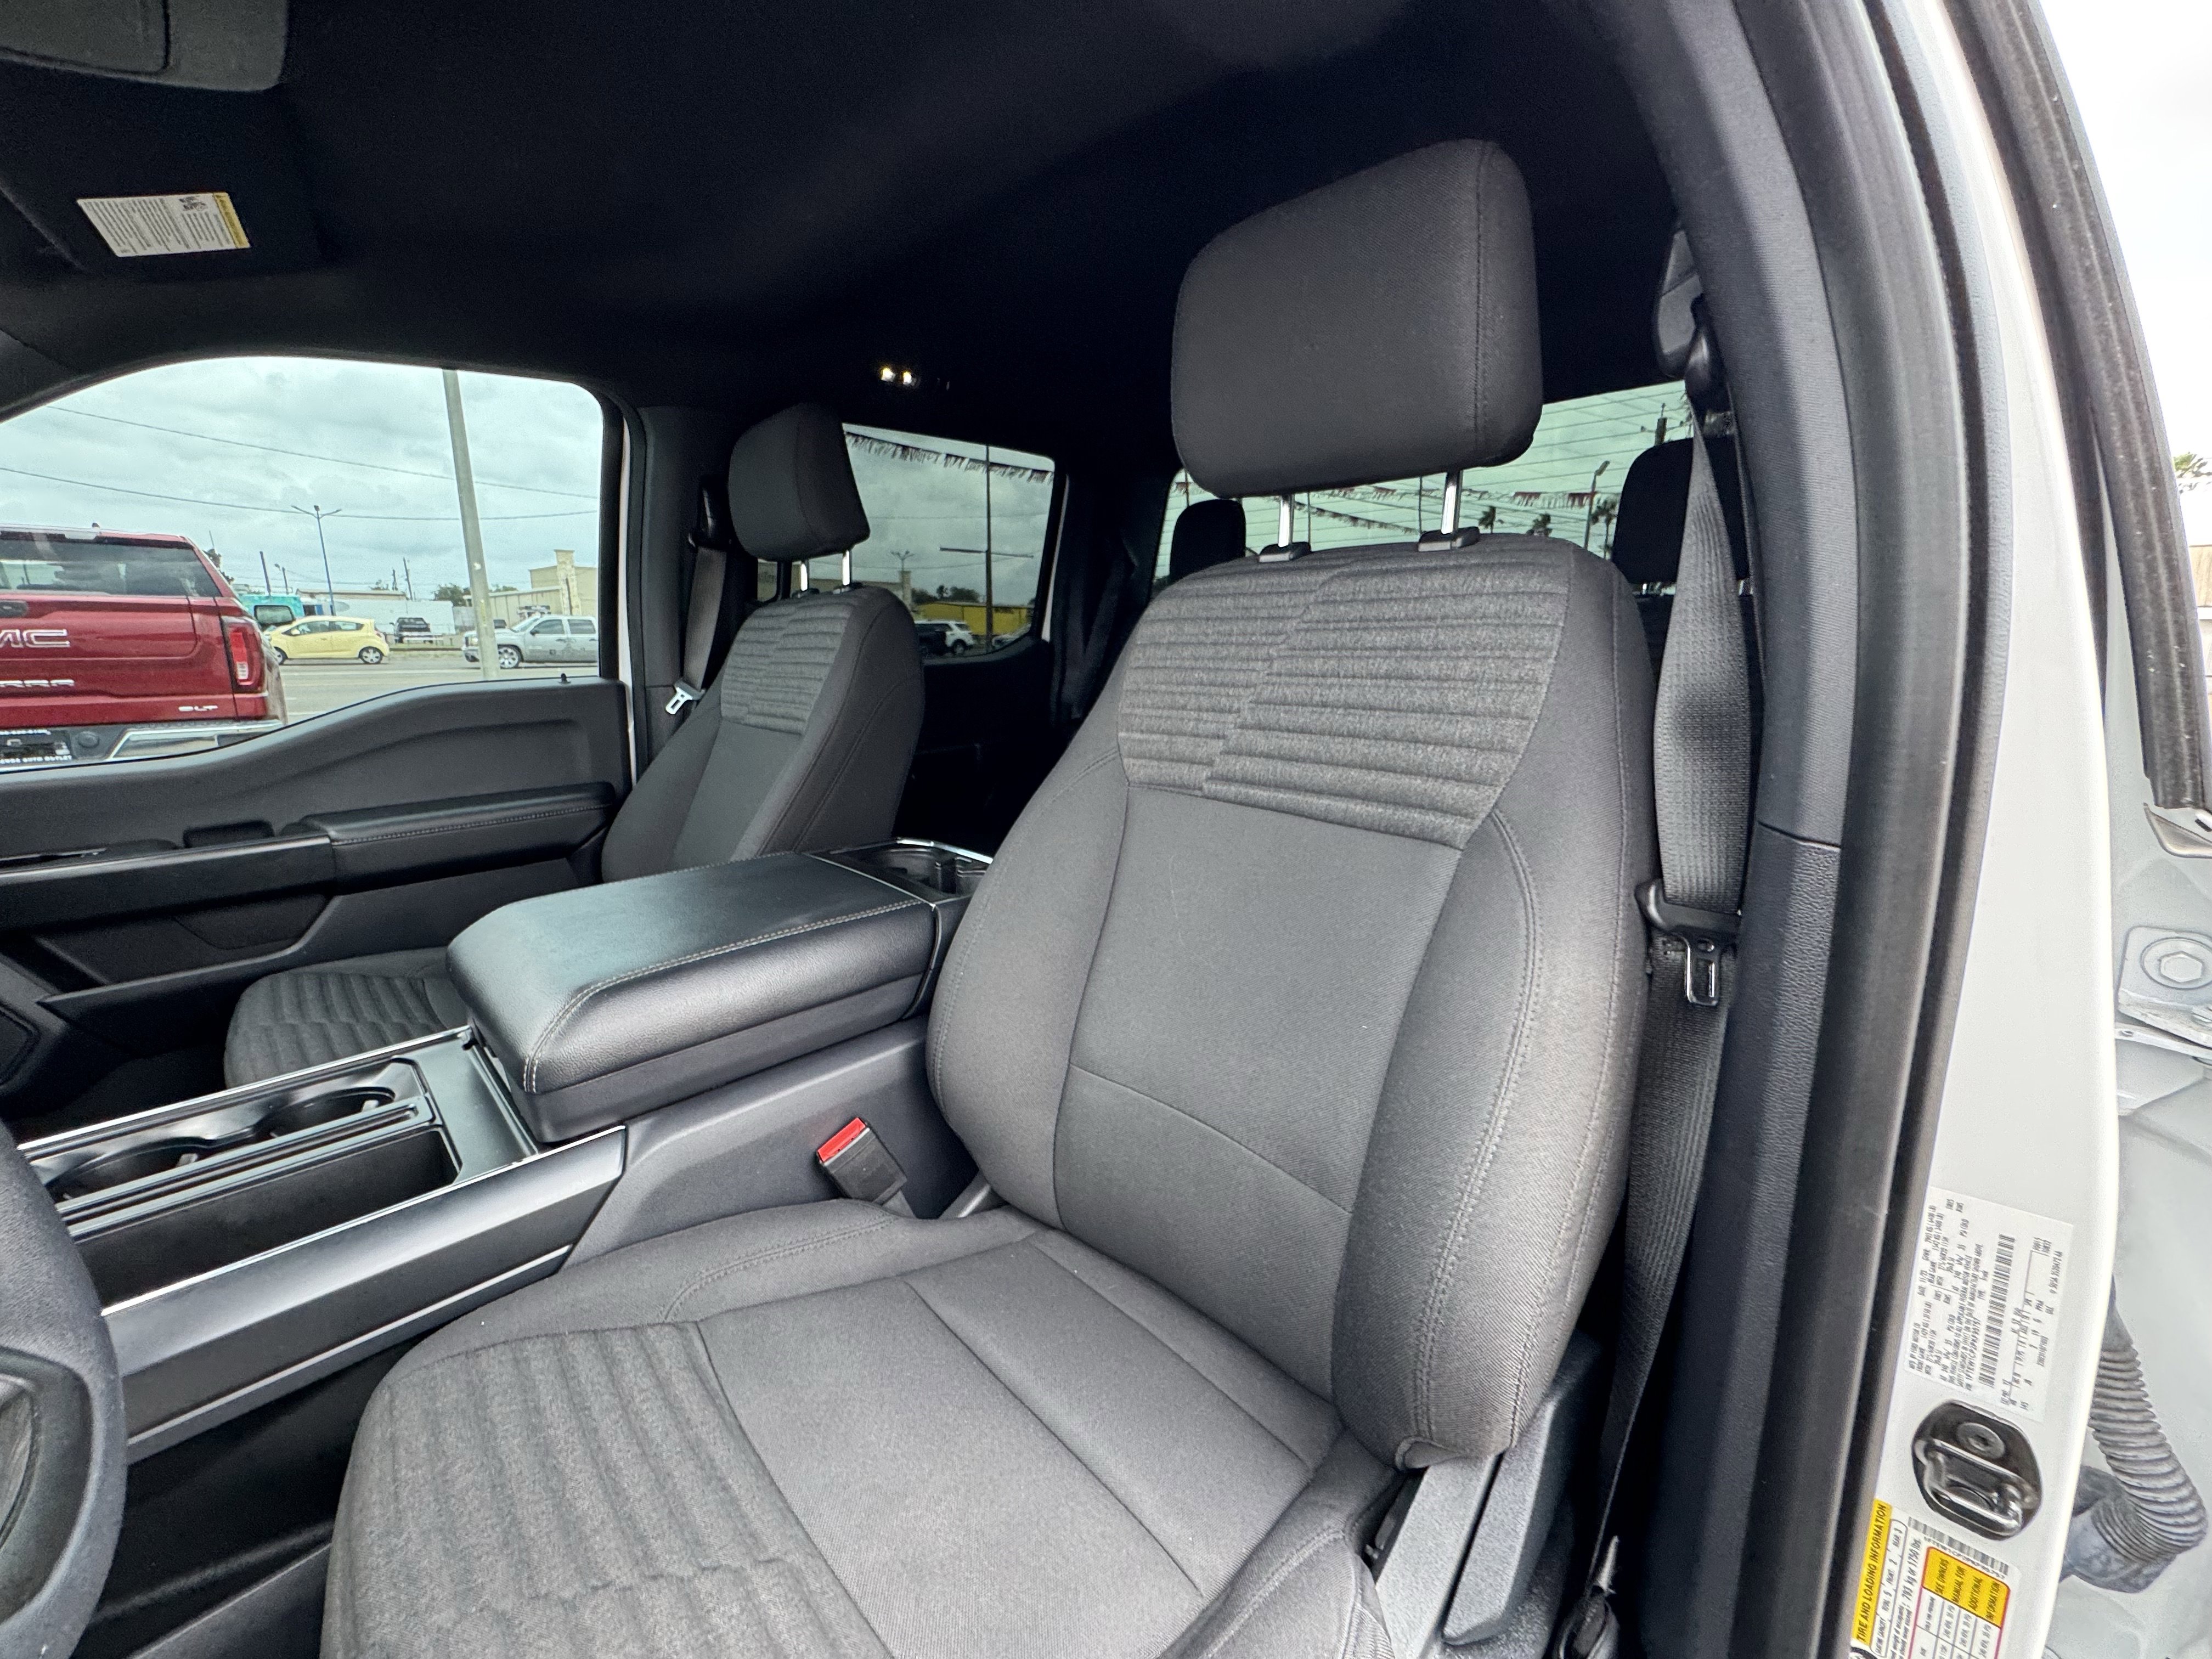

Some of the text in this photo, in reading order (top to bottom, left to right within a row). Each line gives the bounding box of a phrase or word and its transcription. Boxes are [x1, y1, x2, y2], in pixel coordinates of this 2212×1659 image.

[1906, 1548, 1919, 1567] 1750
[1908, 1566, 1916, 1576] or
[1856, 1502, 1887, 1643] TIRE AND LOADING INFORMATION
[1903, 1573, 1916, 1587] kg
[1950, 1564, 1966, 1604] MANUAL FOR
[1934, 1581, 1944, 1595] SEE
[1966, 1574, 1983, 1611] ADDITIONAL
[1984, 1580, 2001, 1621] INFORMATION
